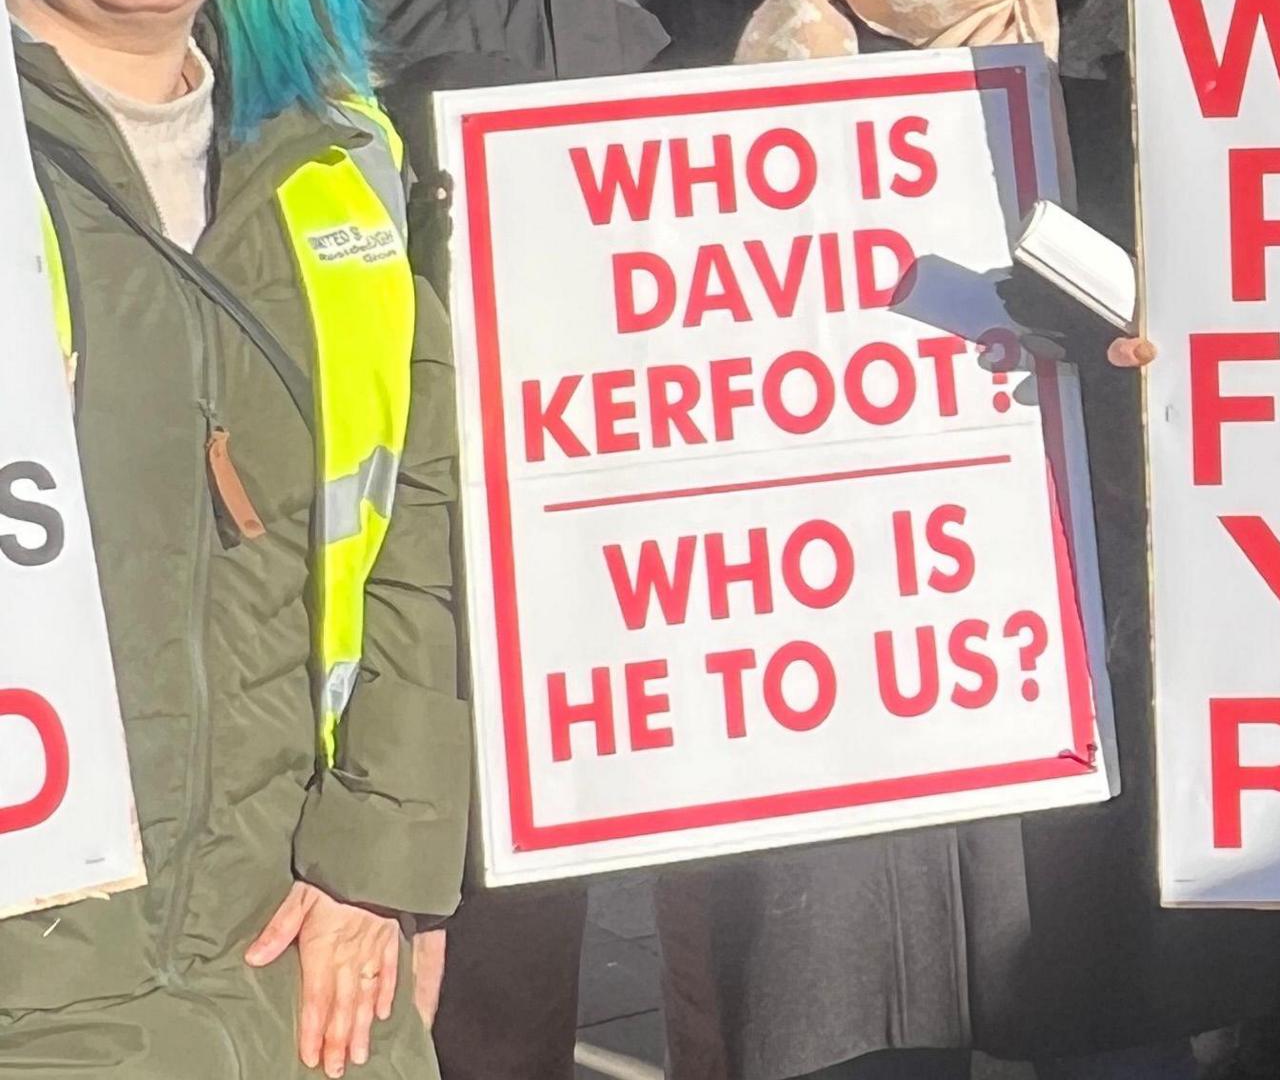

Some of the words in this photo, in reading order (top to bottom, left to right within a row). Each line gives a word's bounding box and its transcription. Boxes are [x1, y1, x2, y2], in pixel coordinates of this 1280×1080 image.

[569, 126, 818, 226] WHO
[855, 115, 938, 200] IS
[612, 228, 916, 334] DAVID
[521, 326, 1012, 463] KERFOOT?
[603, 519, 855, 630] WHO
[891, 503, 975, 598] IS
[546, 657, 674, 763] HE
[705, 639, 836, 739] TO
[873, 609, 1049, 719] US?
